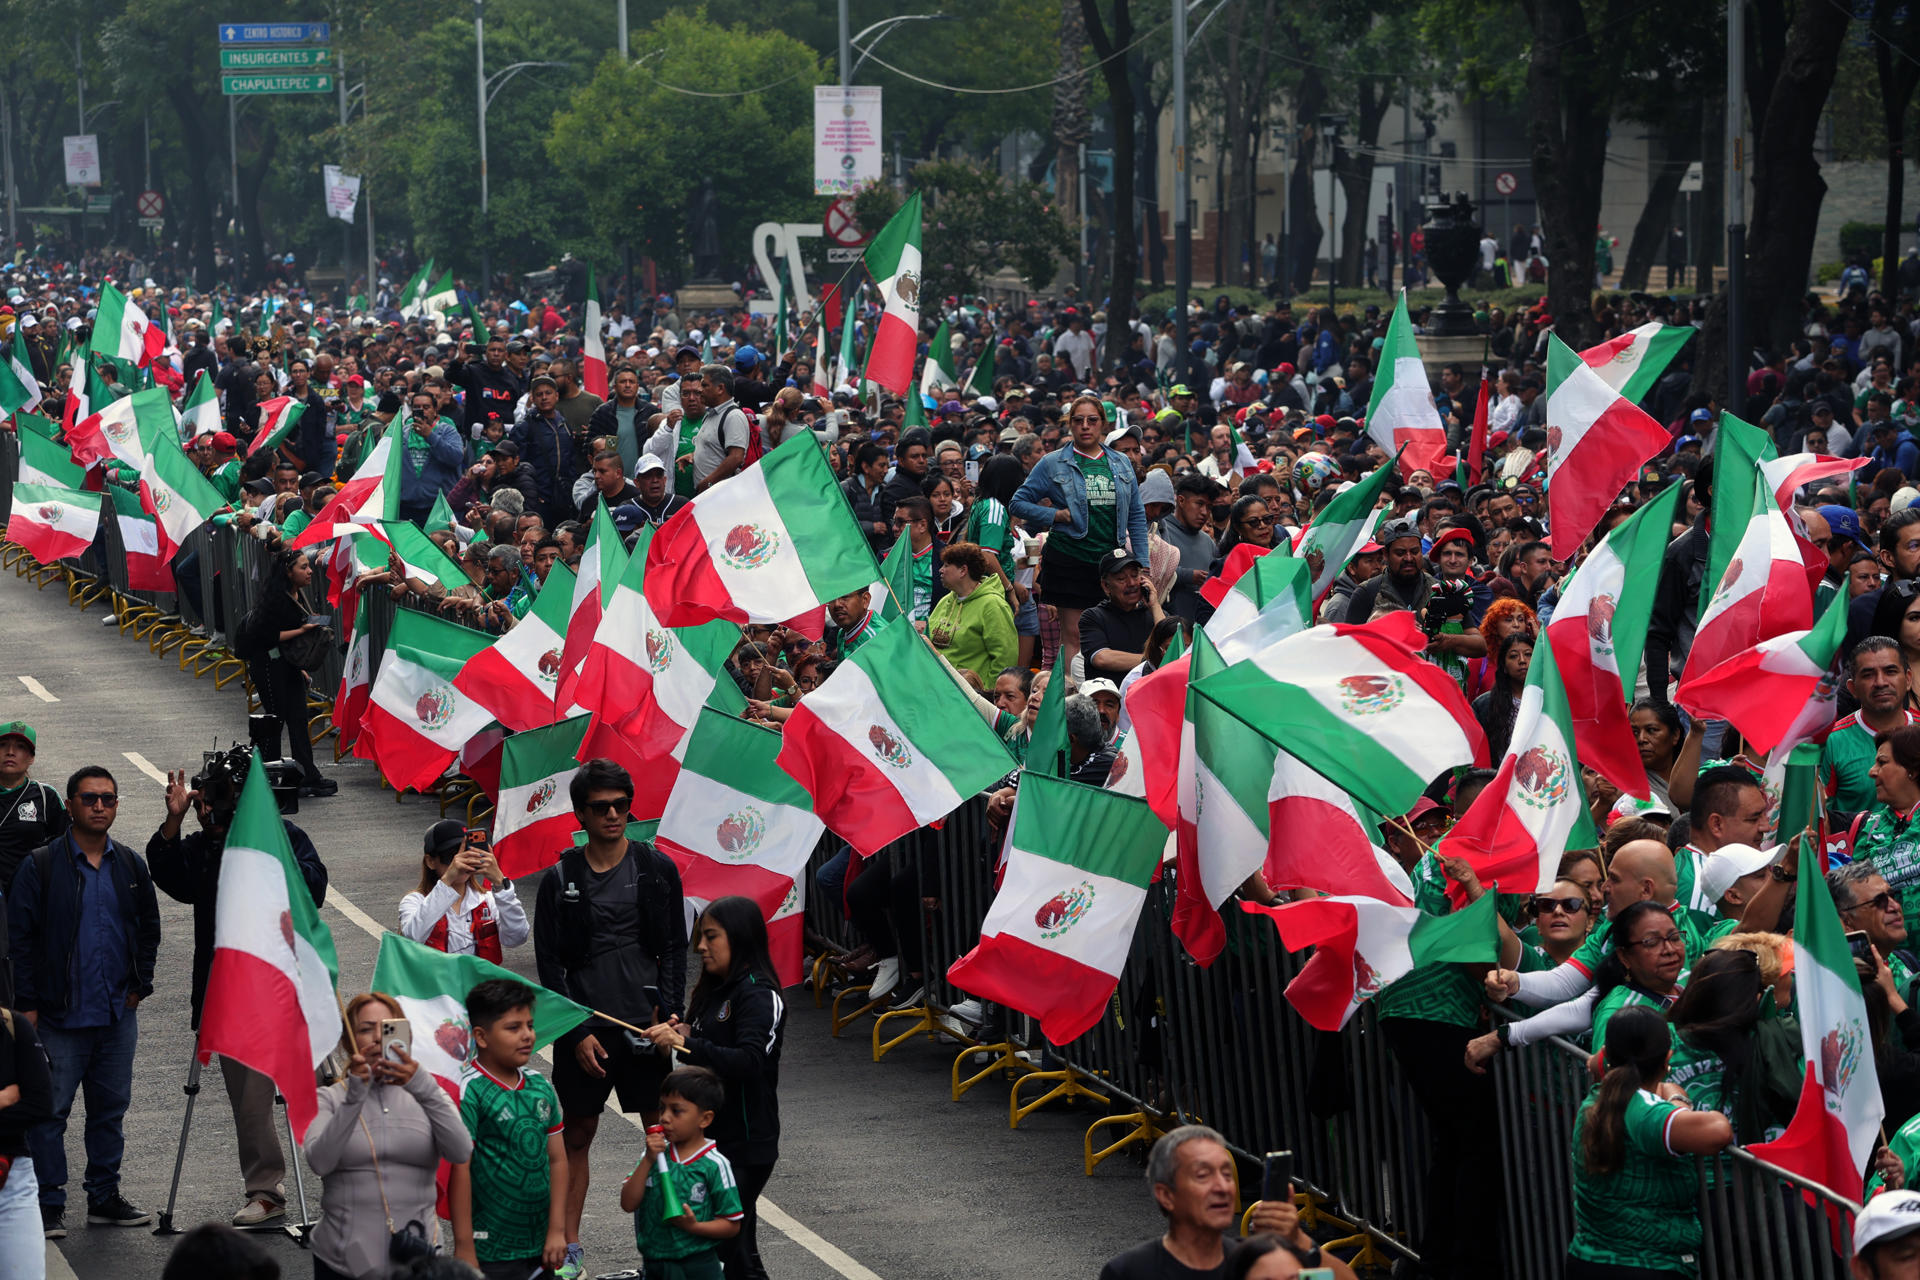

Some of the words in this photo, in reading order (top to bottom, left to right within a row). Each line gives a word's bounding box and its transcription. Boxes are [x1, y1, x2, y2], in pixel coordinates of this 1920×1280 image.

[244, 27, 268, 39] CENTRO
[229, 52, 309, 64] INSURGENTES
[231, 78, 310, 91] CHAPULTEPEC
[483, 387, 511, 400] FILA
[1695, 1059, 1712, 1074] 12
